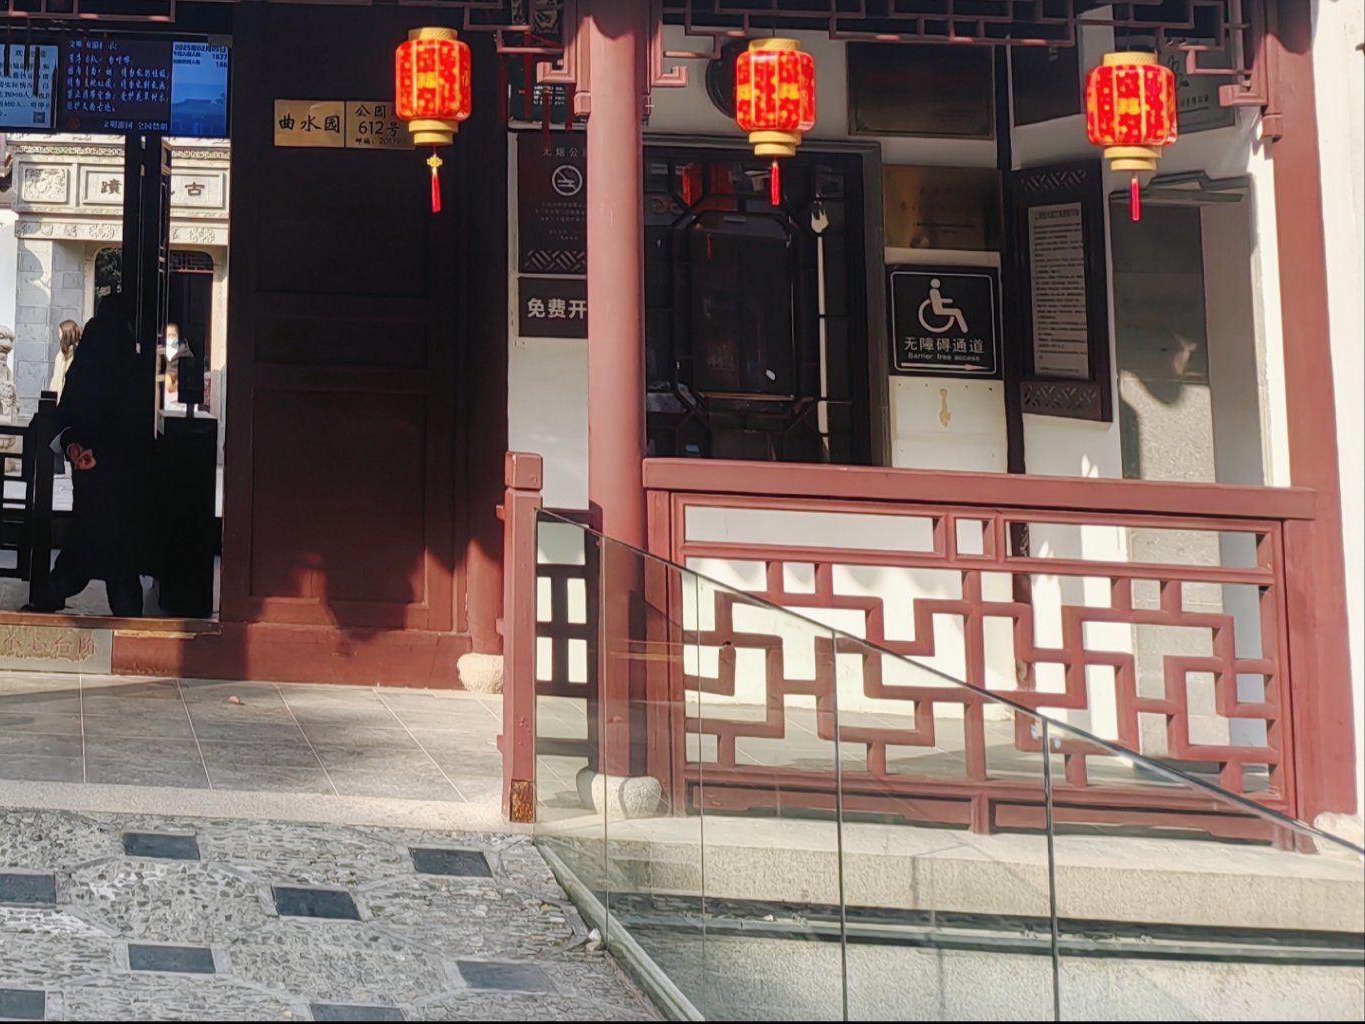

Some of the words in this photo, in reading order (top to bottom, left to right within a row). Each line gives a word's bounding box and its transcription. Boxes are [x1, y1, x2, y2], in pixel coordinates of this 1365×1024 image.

[355, 104, 396, 119] 公园
[278, 113, 341, 133] 曲水园
[358, 120, 400, 137] 612号
[904, 337, 985, 354] 无障碍通道
